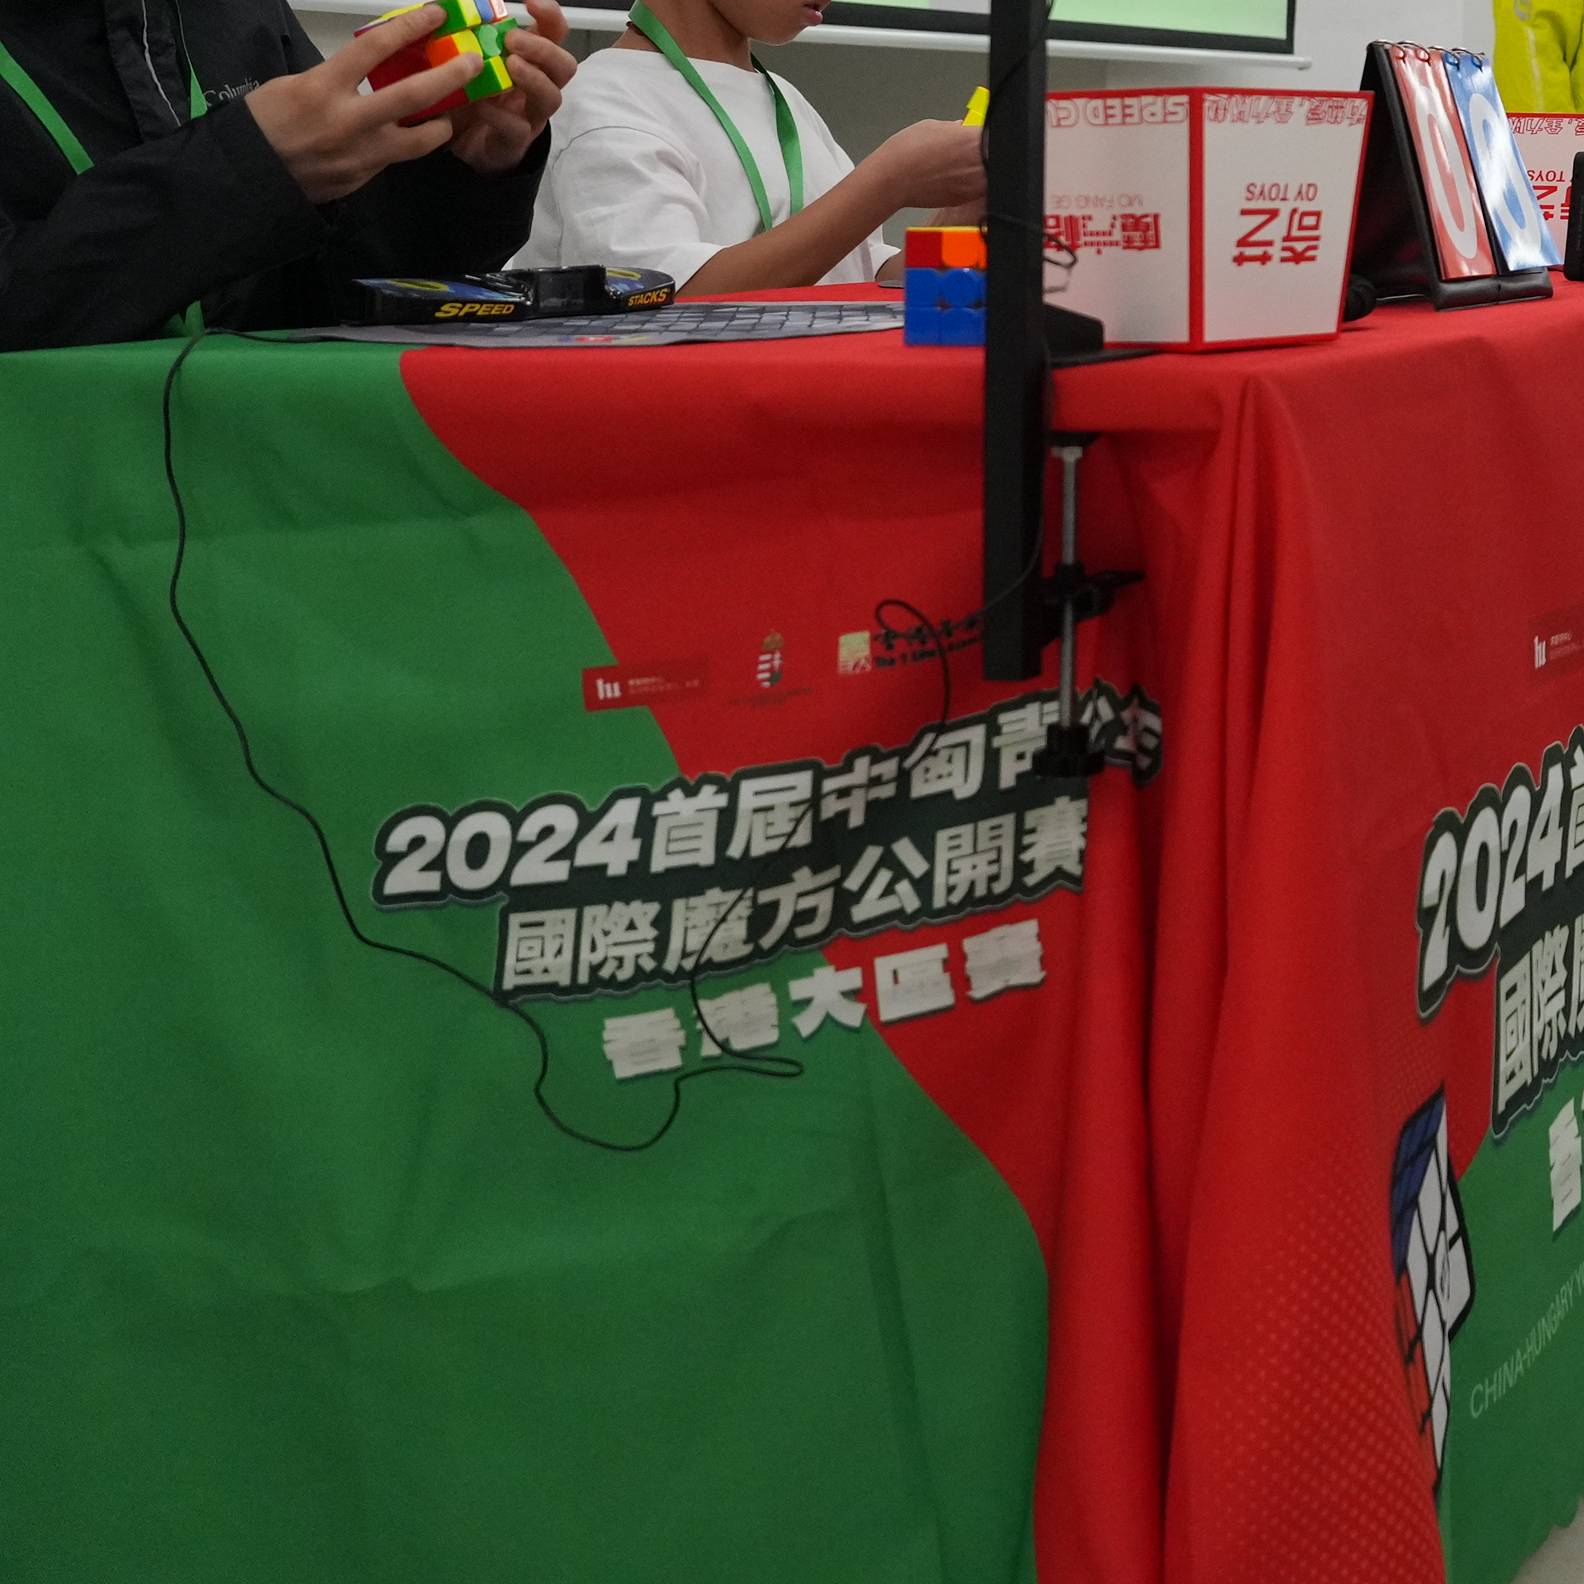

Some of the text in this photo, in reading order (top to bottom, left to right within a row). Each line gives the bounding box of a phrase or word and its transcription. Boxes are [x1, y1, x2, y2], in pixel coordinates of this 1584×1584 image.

[1086, 95, 1190, 127] SPEED
[1246, 182, 1318, 202] QY TOYS
[1232, 206, 1323, 267] 奇艺
[435, 302, 516, 318] SPEED
[627, 287, 670, 307] STACKS
[502, 795, 1088, 990] 國際魔方公開賽
[1470, 1280, 1575, 1417] CHINA-HUNGARY
